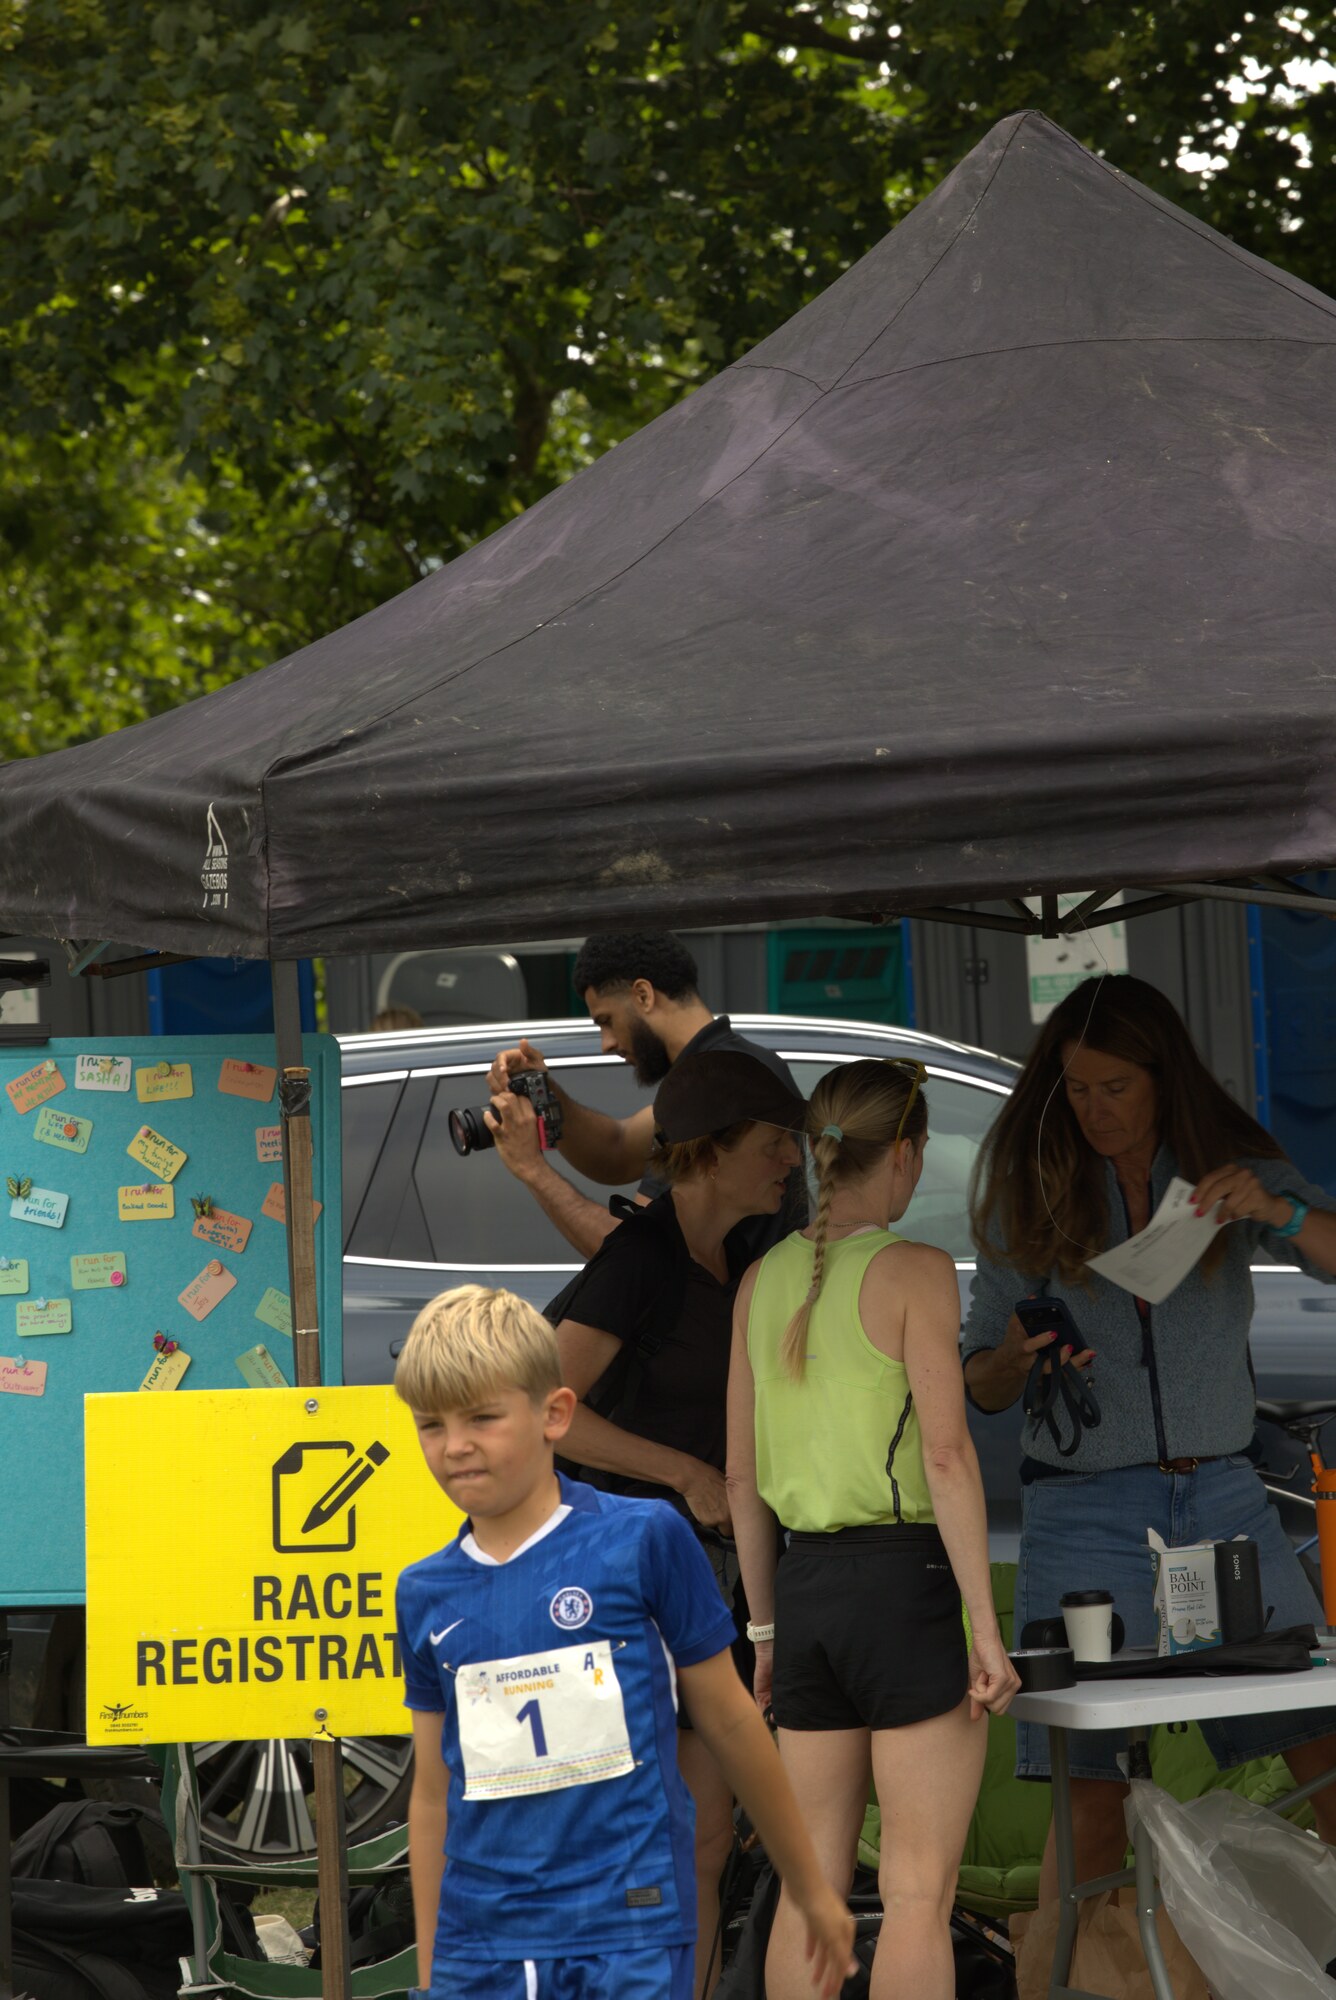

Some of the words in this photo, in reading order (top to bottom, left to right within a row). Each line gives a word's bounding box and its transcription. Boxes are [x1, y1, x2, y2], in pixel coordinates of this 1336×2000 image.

[16, 1077, 31, 1088] run
[31, 1067, 44, 1080] for
[51, 1113, 67, 1123] run
[69, 1116, 83, 1127] for
[151, 1135, 165, 1148] run
[166, 1143, 179, 1156] for
[151, 1186, 165, 1195] for
[43, 1197, 57, 1209] for
[24, 1206, 61, 1224] friends!
[225, 1215, 241, 1226] for
[83, 1256, 99, 1265] run
[103, 1254, 117, 1263] for
[186, 1283, 202, 1298] run
[198, 1272, 212, 1286] for
[47, 1301, 62, 1311] for
[2, 1367, 18, 1375] run
[149, 1366, 162, 1385] run
[1232, 1554, 1241, 1580] SONOS
[1169, 1571, 1201, 1583] BALL
[253, 1572, 384, 1621] RACE
[1170, 1581, 1206, 1594] POINT
[584, 1652, 595, 1671] A
[496, 1664, 560, 1683] AFFORDABLE
[593, 1668, 604, 1686] R
[504, 1679, 554, 1696] RUNNING
[516, 1699, 549, 1758] 1
